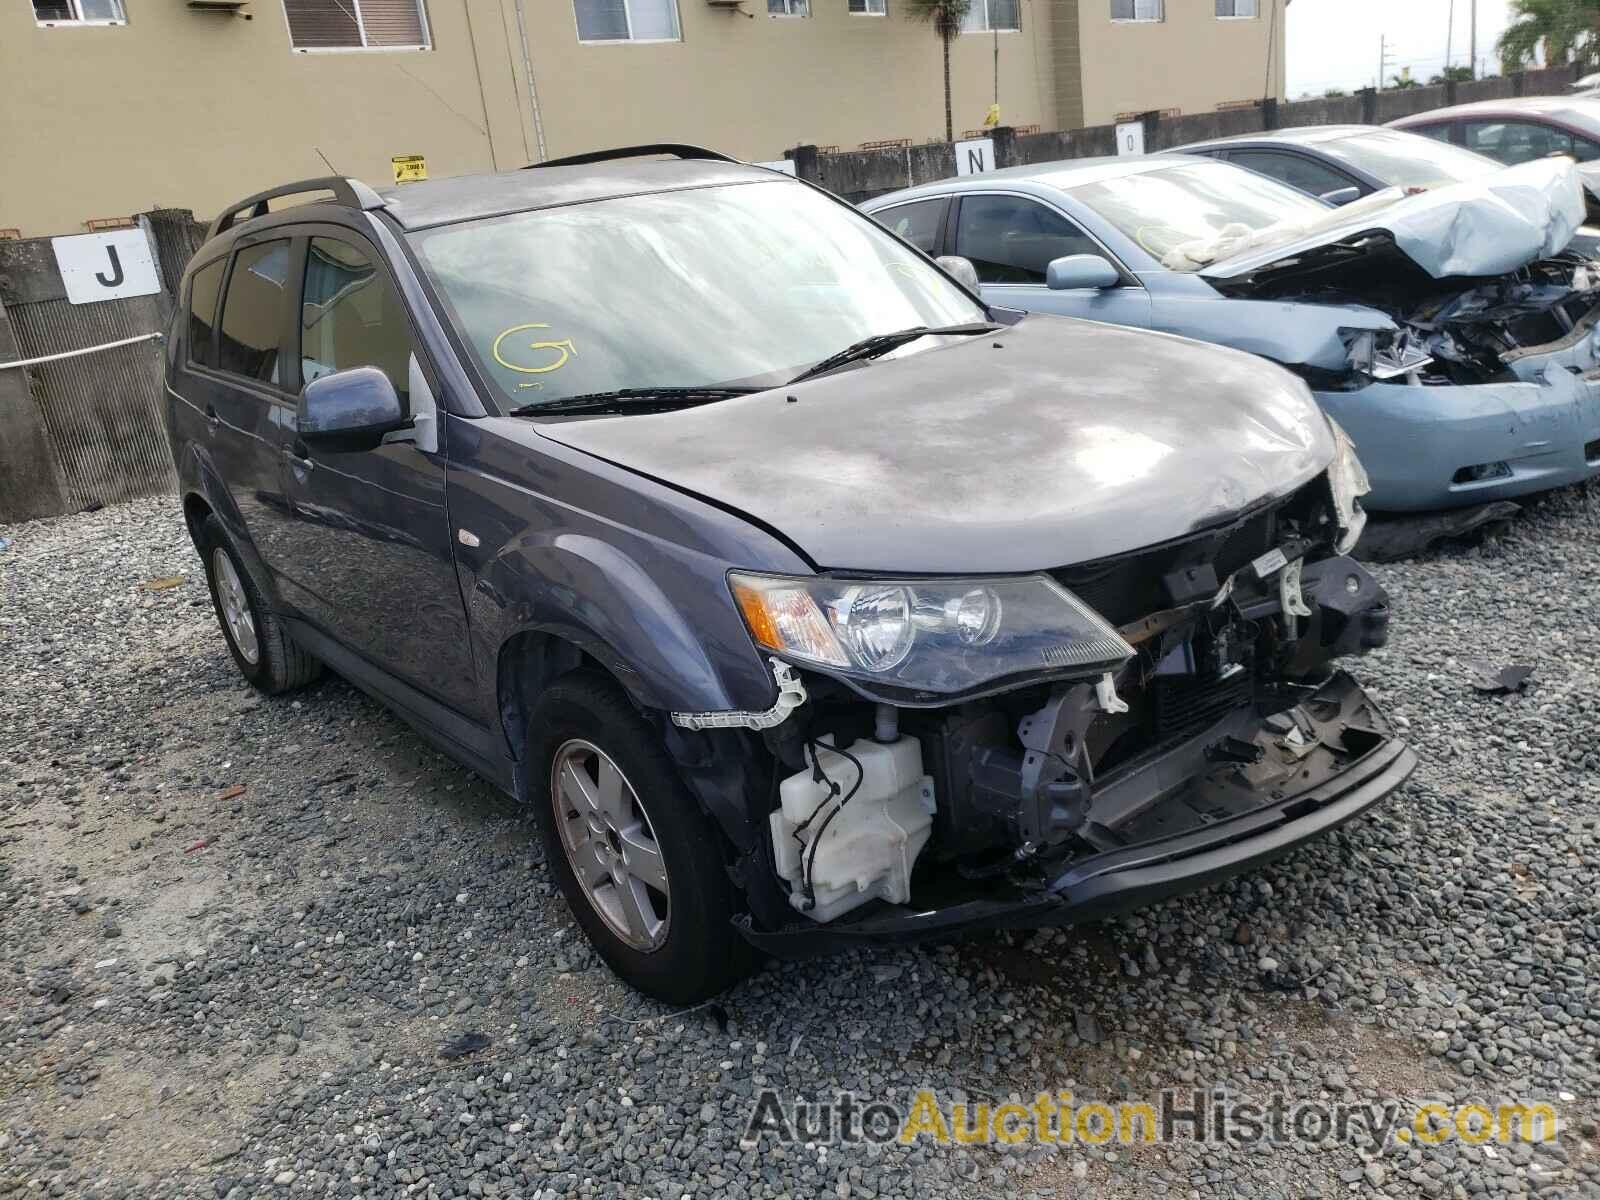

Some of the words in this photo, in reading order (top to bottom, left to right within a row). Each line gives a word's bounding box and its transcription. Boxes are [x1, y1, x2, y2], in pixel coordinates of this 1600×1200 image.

[968, 147, 984, 174] N
[95, 244, 124, 288] J
[493, 323, 577, 374] G
